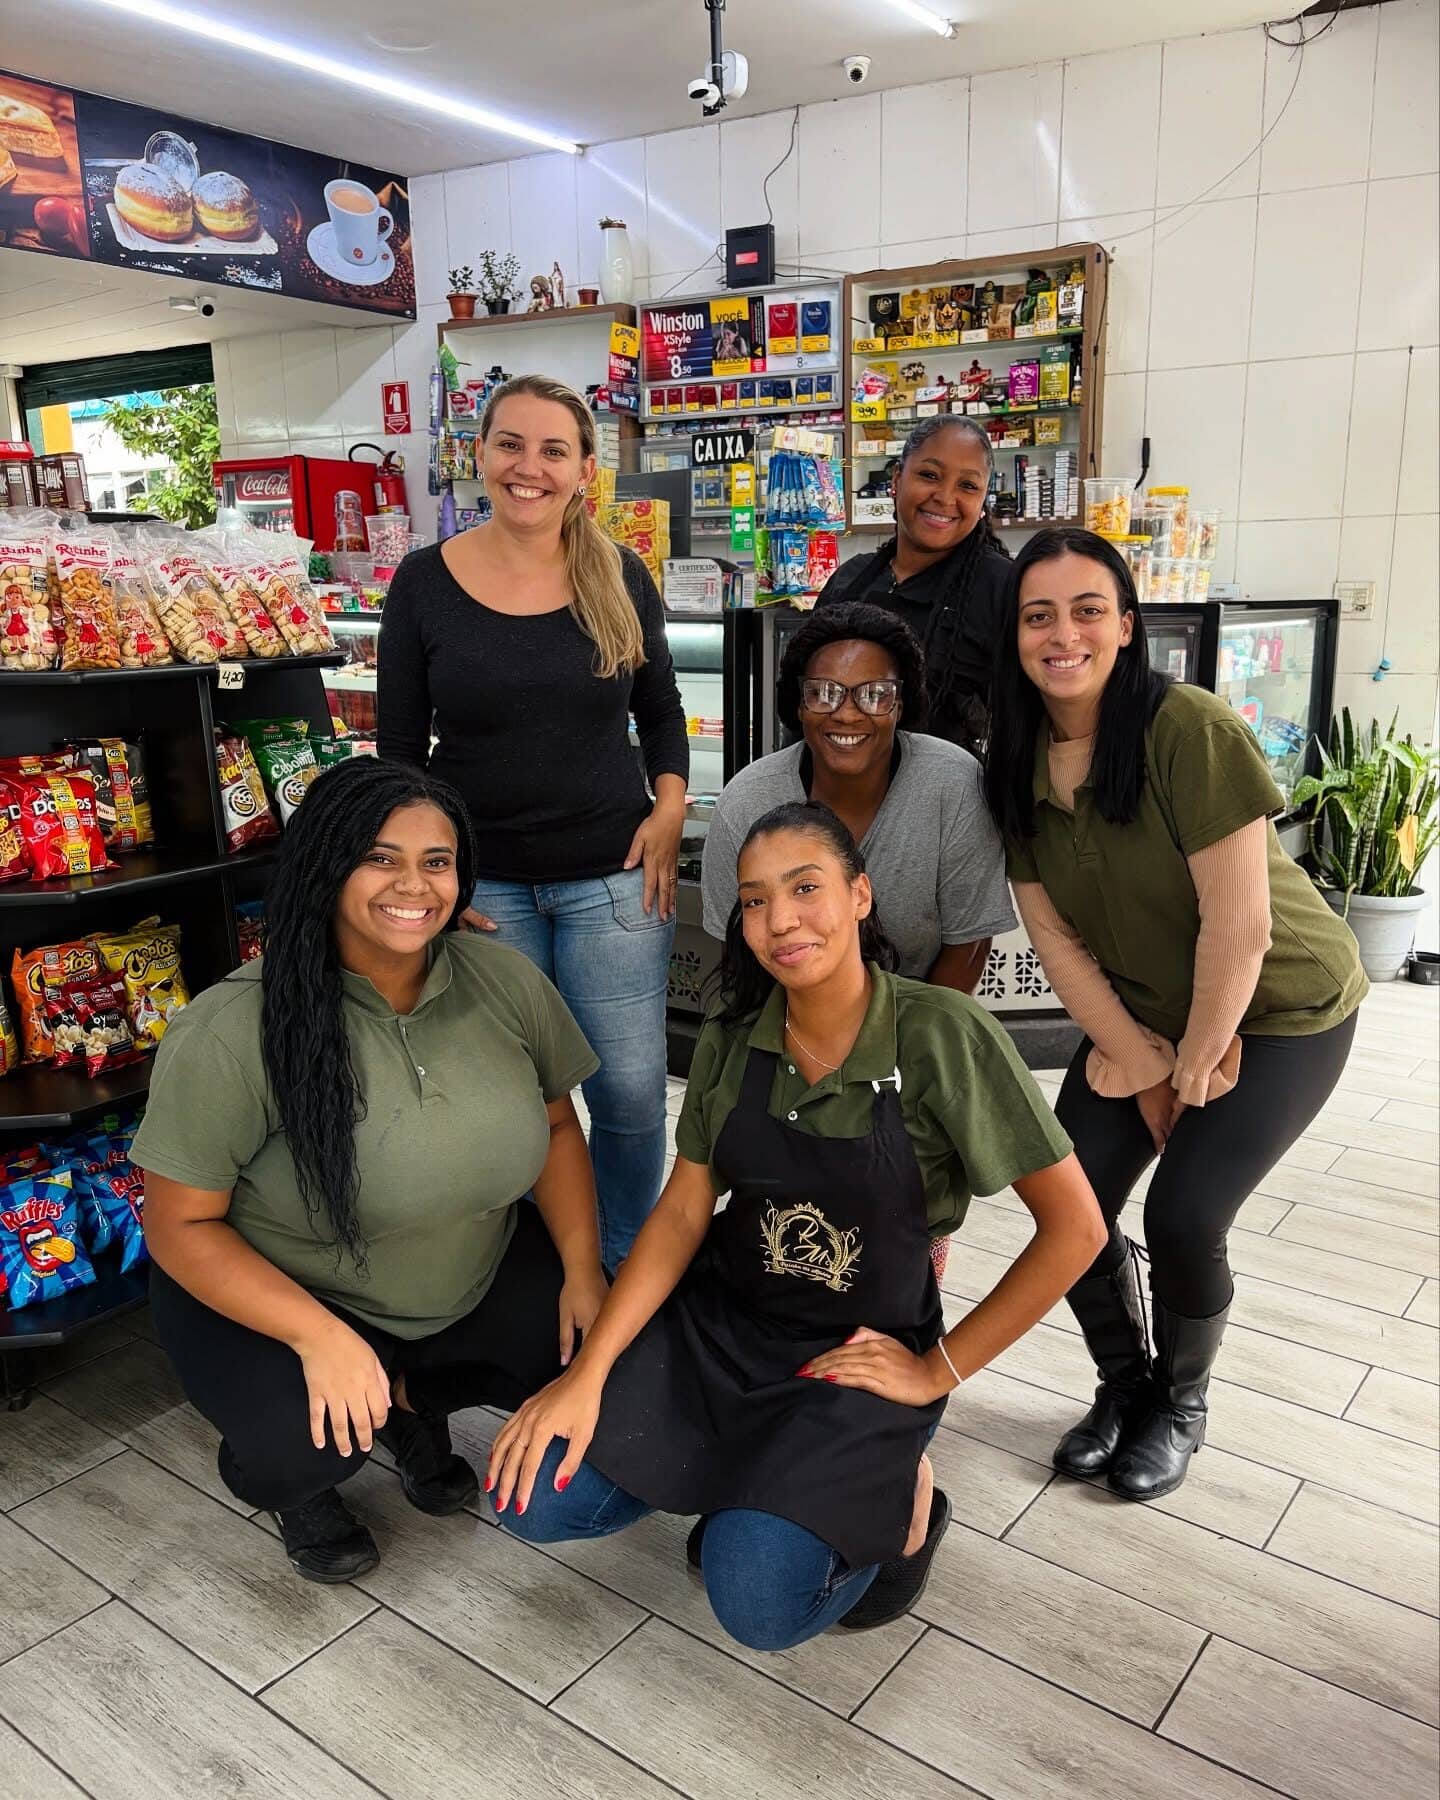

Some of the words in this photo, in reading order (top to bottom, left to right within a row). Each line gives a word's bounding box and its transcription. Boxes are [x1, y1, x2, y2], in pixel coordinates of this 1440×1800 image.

[650, 312, 704, 334] Winston
[663, 332, 692, 347] XStyle
[694, 434, 746, 463] CAIXA
[242, 473, 289, 497] Coca-Cola
[56, 543, 108, 557] Ritinha
[0, 1197, 65, 1232] Ruffles
